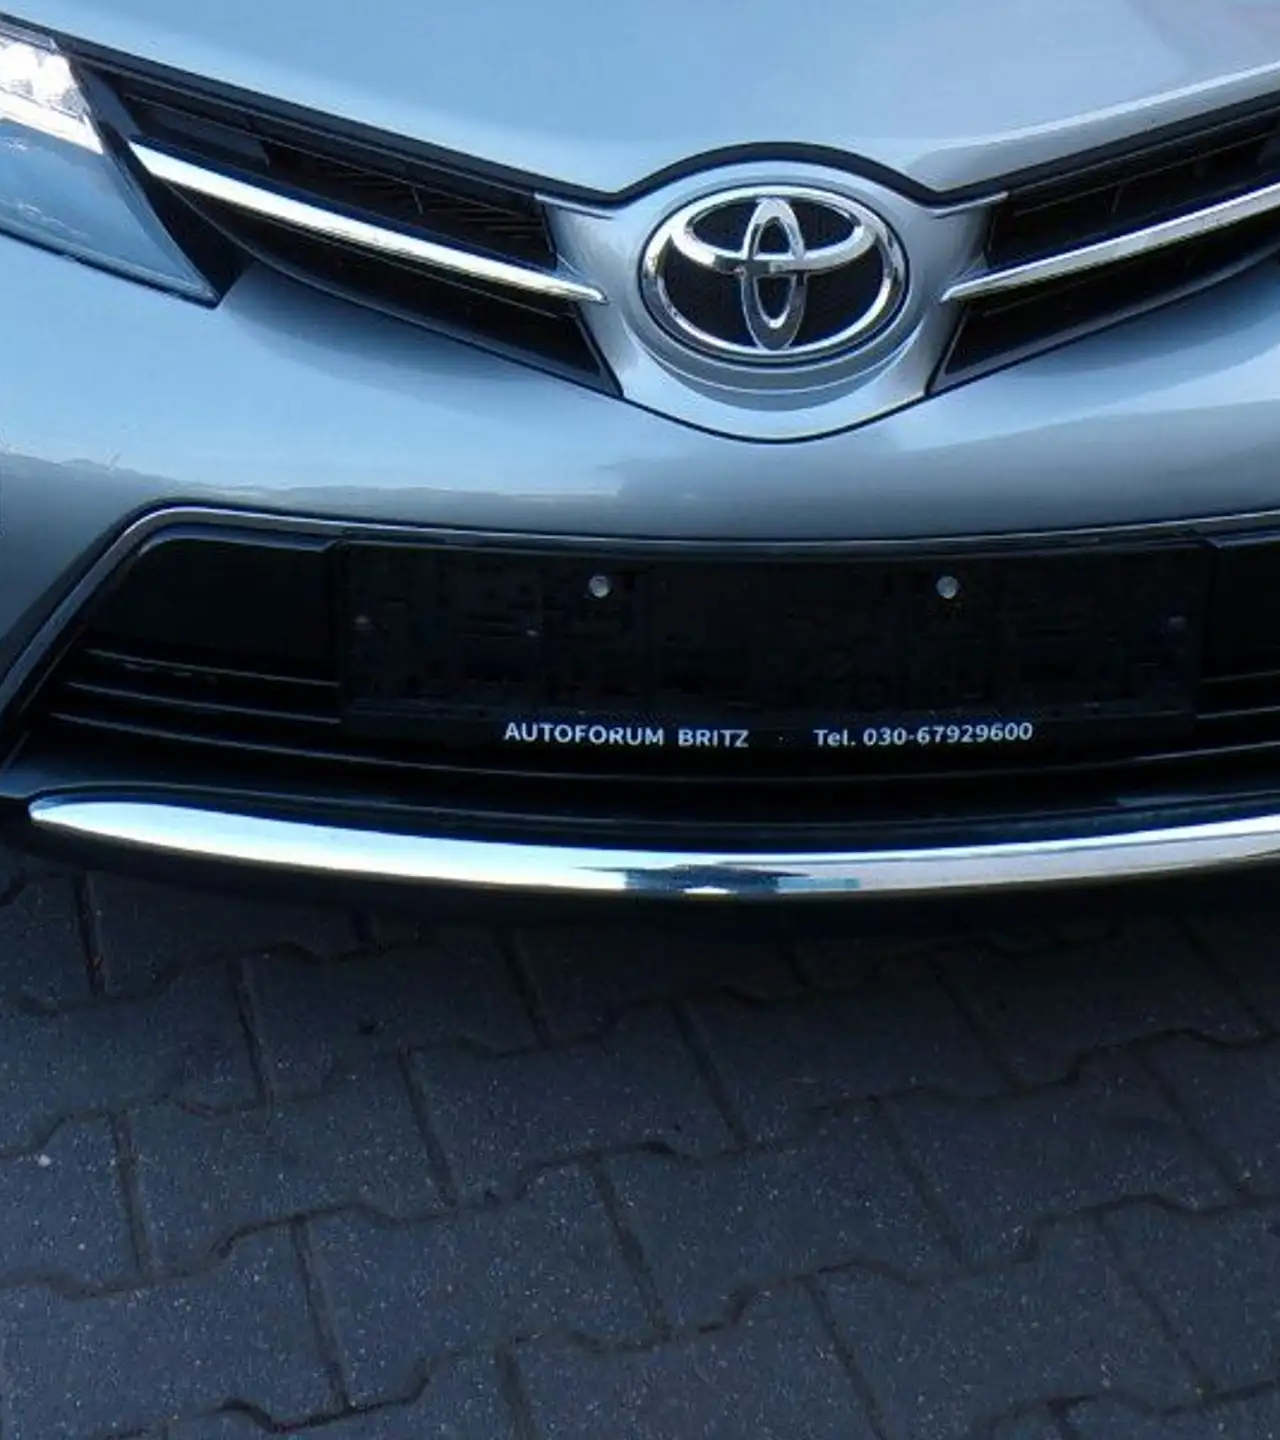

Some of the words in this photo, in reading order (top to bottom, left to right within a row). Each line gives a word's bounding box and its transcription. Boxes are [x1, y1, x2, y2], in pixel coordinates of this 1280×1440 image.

[504, 721, 665, 746] AUTOFORUM
[677, 728, 750, 748] BRITZ
[813, 728, 857, 747] Tel.
[862, 721, 1034, 747] 030-67929600
